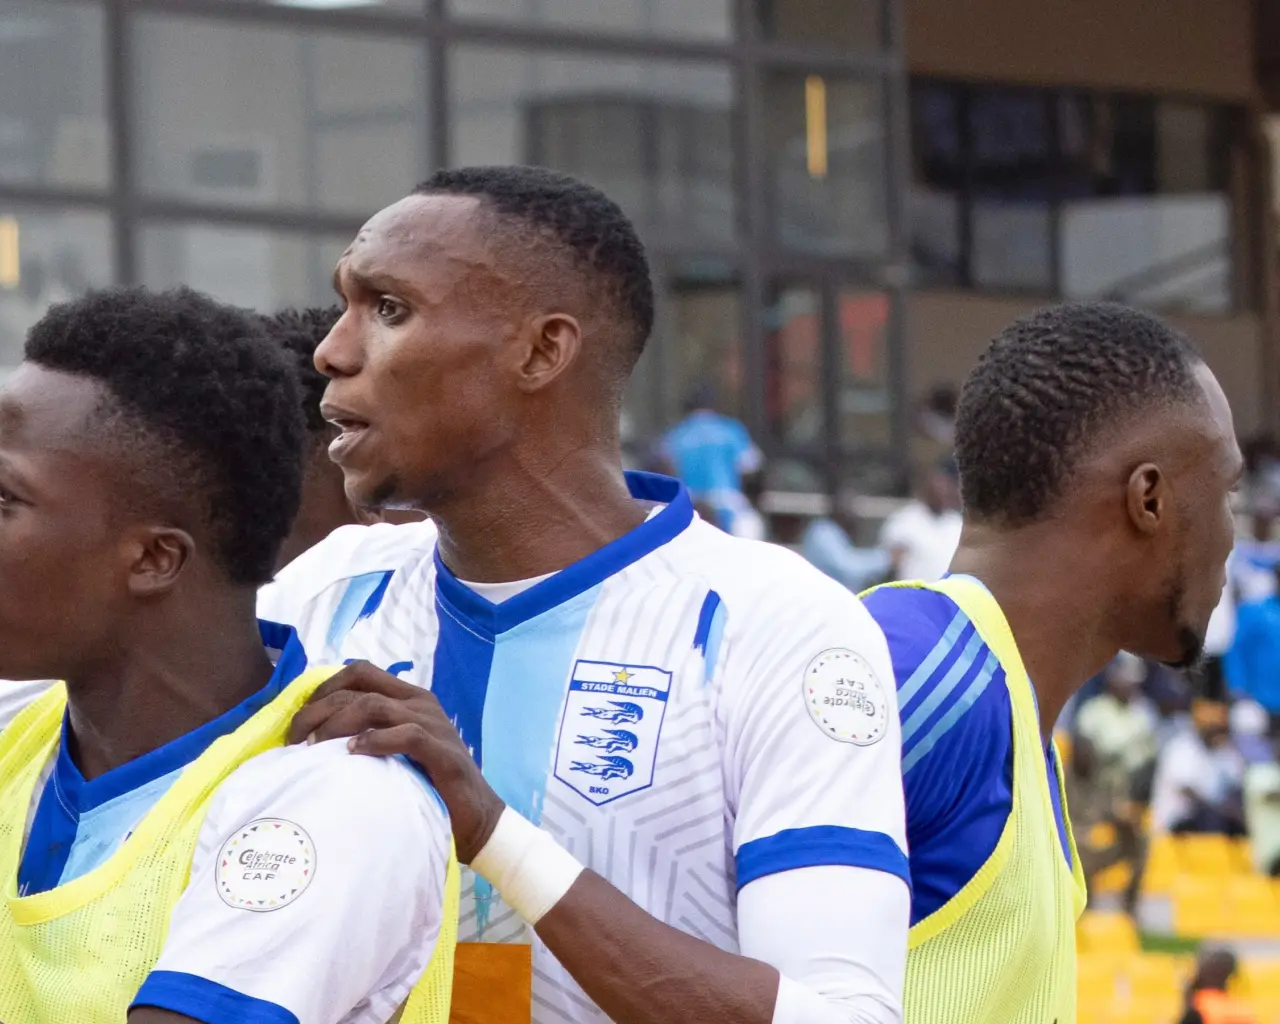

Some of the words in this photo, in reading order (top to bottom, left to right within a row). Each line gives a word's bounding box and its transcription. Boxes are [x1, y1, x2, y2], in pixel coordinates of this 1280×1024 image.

[835, 678, 865, 690] CAF
[581, 682, 615, 693] STADE
[616, 685, 658, 698] MALIEN
[588, 785, 610, 795] BKO
[242, 872, 276, 881] CAF
